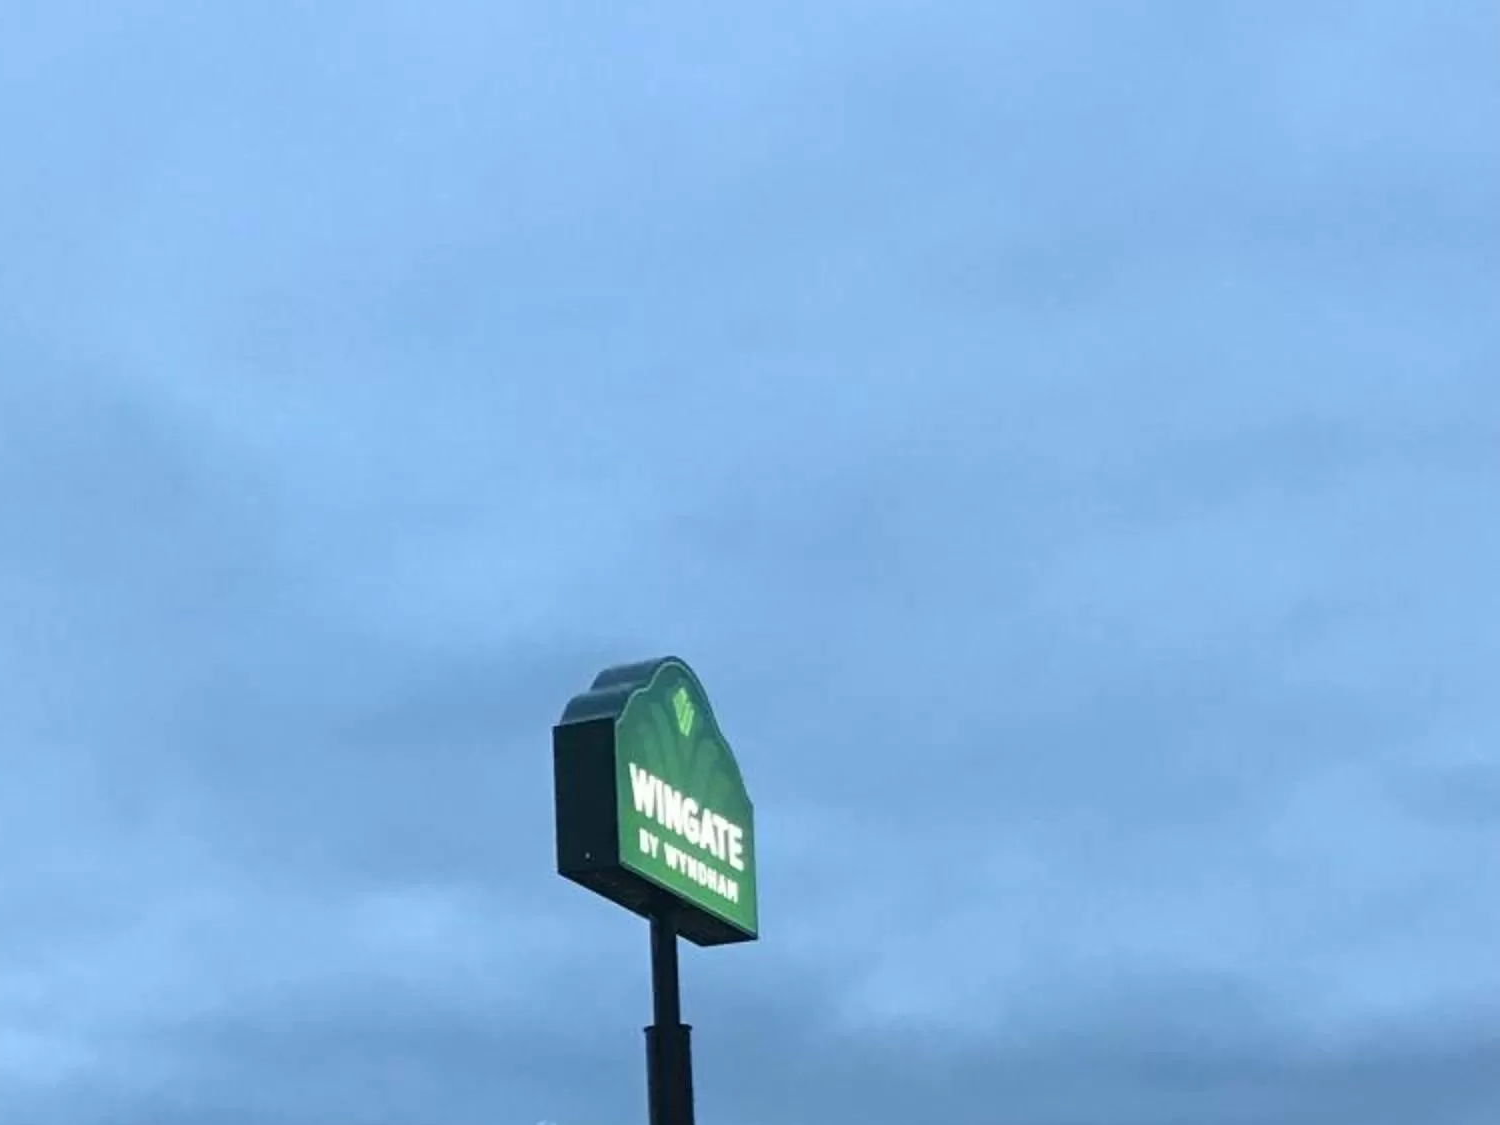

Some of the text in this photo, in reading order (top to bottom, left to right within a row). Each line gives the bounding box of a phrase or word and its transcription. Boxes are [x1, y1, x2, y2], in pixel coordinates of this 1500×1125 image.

[628, 762, 744, 871] WINGATE
[639, 827, 739, 904] BY WYNDHAM
